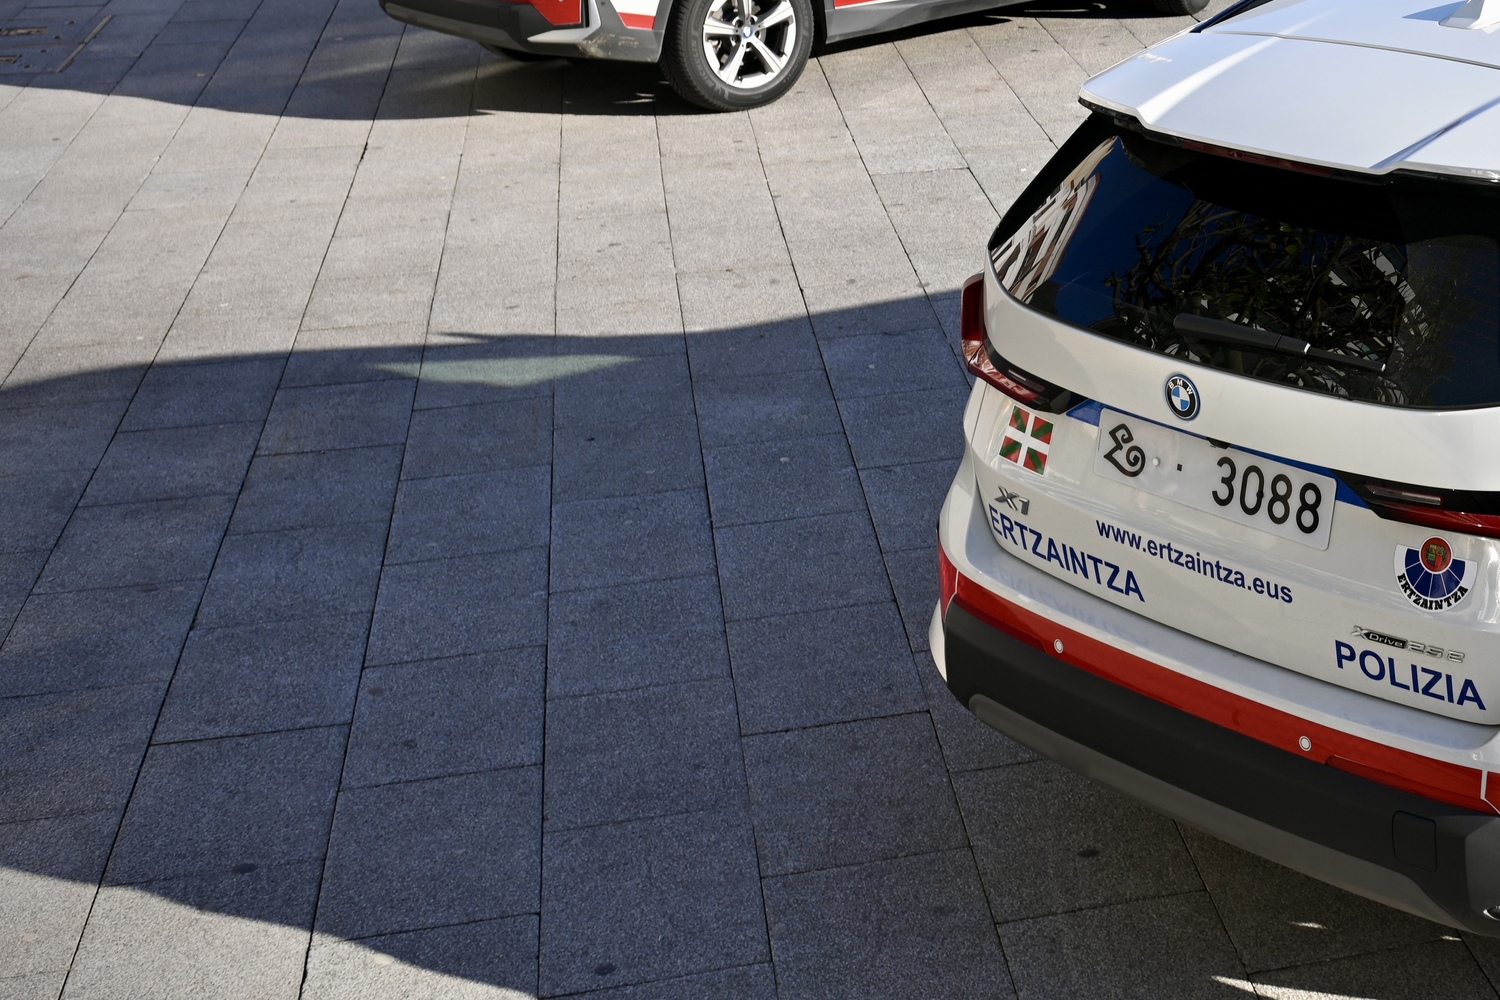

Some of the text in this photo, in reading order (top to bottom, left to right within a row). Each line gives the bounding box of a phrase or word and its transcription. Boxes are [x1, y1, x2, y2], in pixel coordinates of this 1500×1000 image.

[994, 485, 1030, 516] X1
[1211, 456, 1322, 535] 3088
[988, 503, 1146, 604] ERTZAINTZA
[1096, 519, 1294, 604] www.ertzaintza.eus
[1397, 572, 1469, 611] ERTZAINTZA
[1334, 639, 1487, 711] POLIZIA
